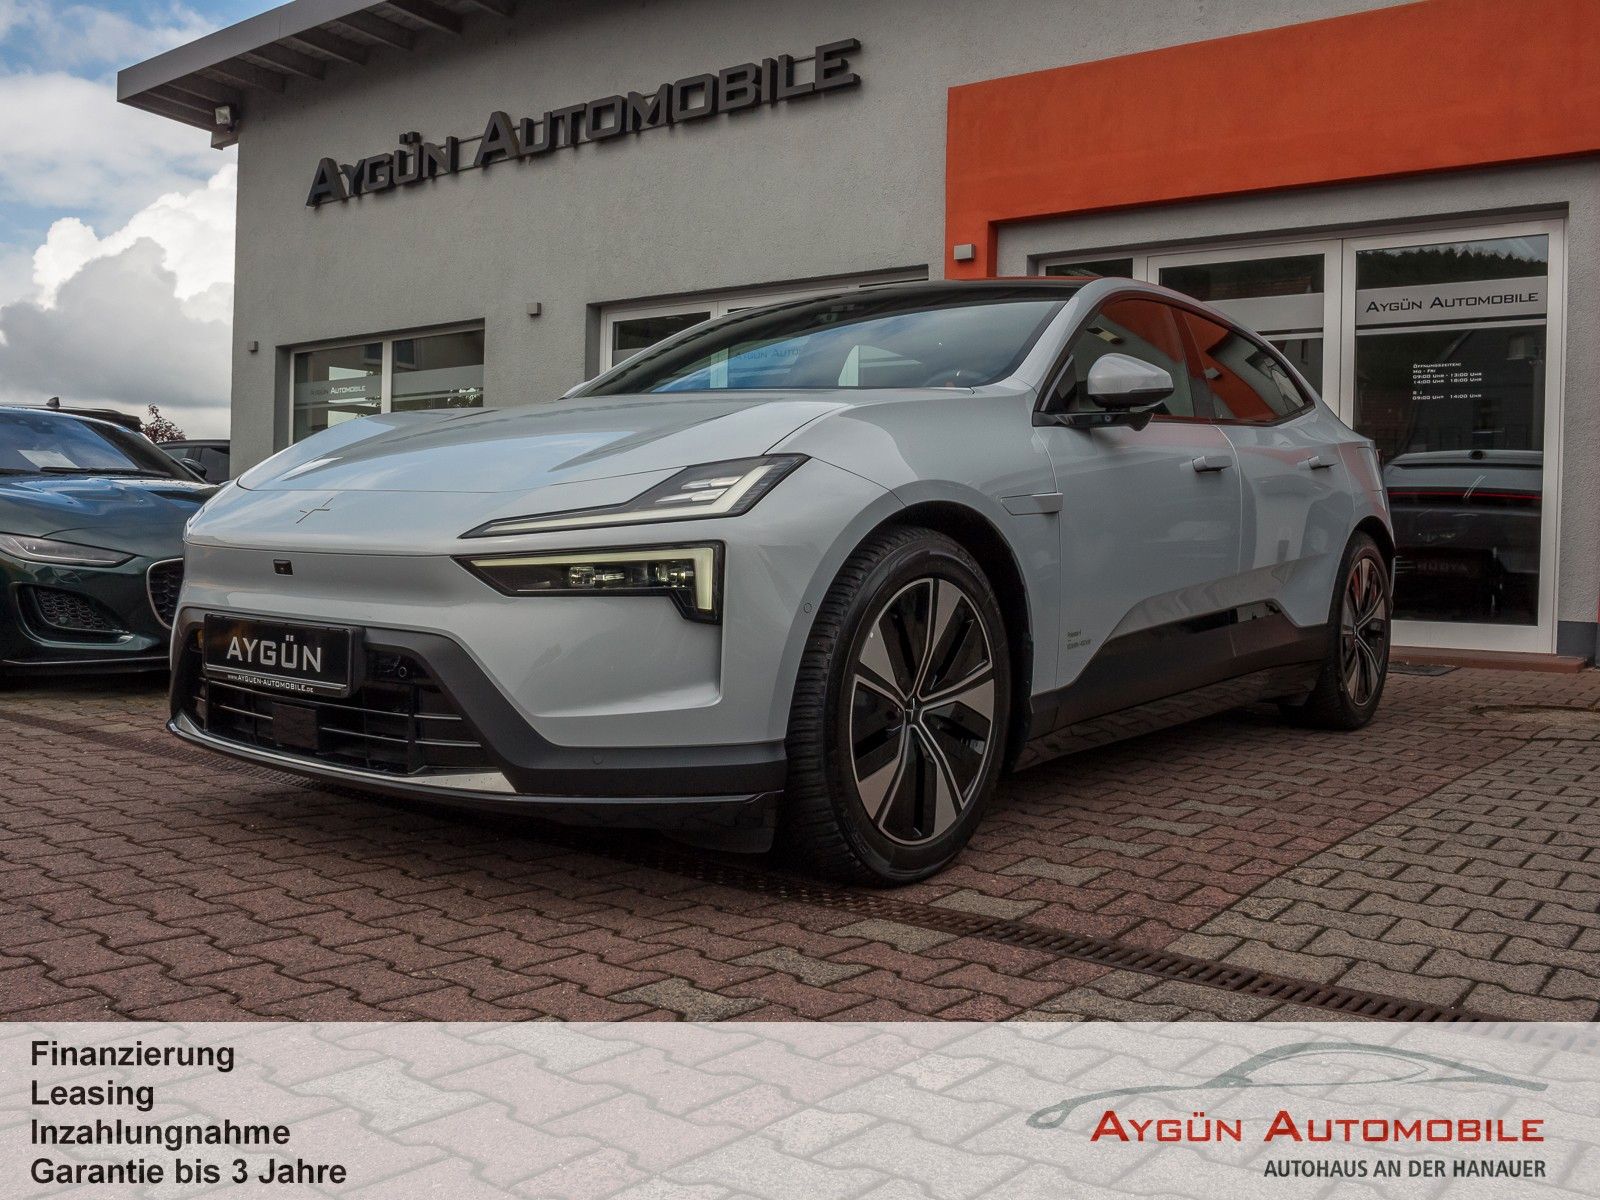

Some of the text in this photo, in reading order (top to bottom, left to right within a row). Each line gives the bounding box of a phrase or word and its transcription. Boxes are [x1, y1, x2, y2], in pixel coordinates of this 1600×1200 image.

[305, 38, 861, 207] AYGÜN AUTOMOBILE
[1365, 292, 1539, 313] AYGÜN AUTOMOBILE
[226, 634, 322, 673] AYGÜN
